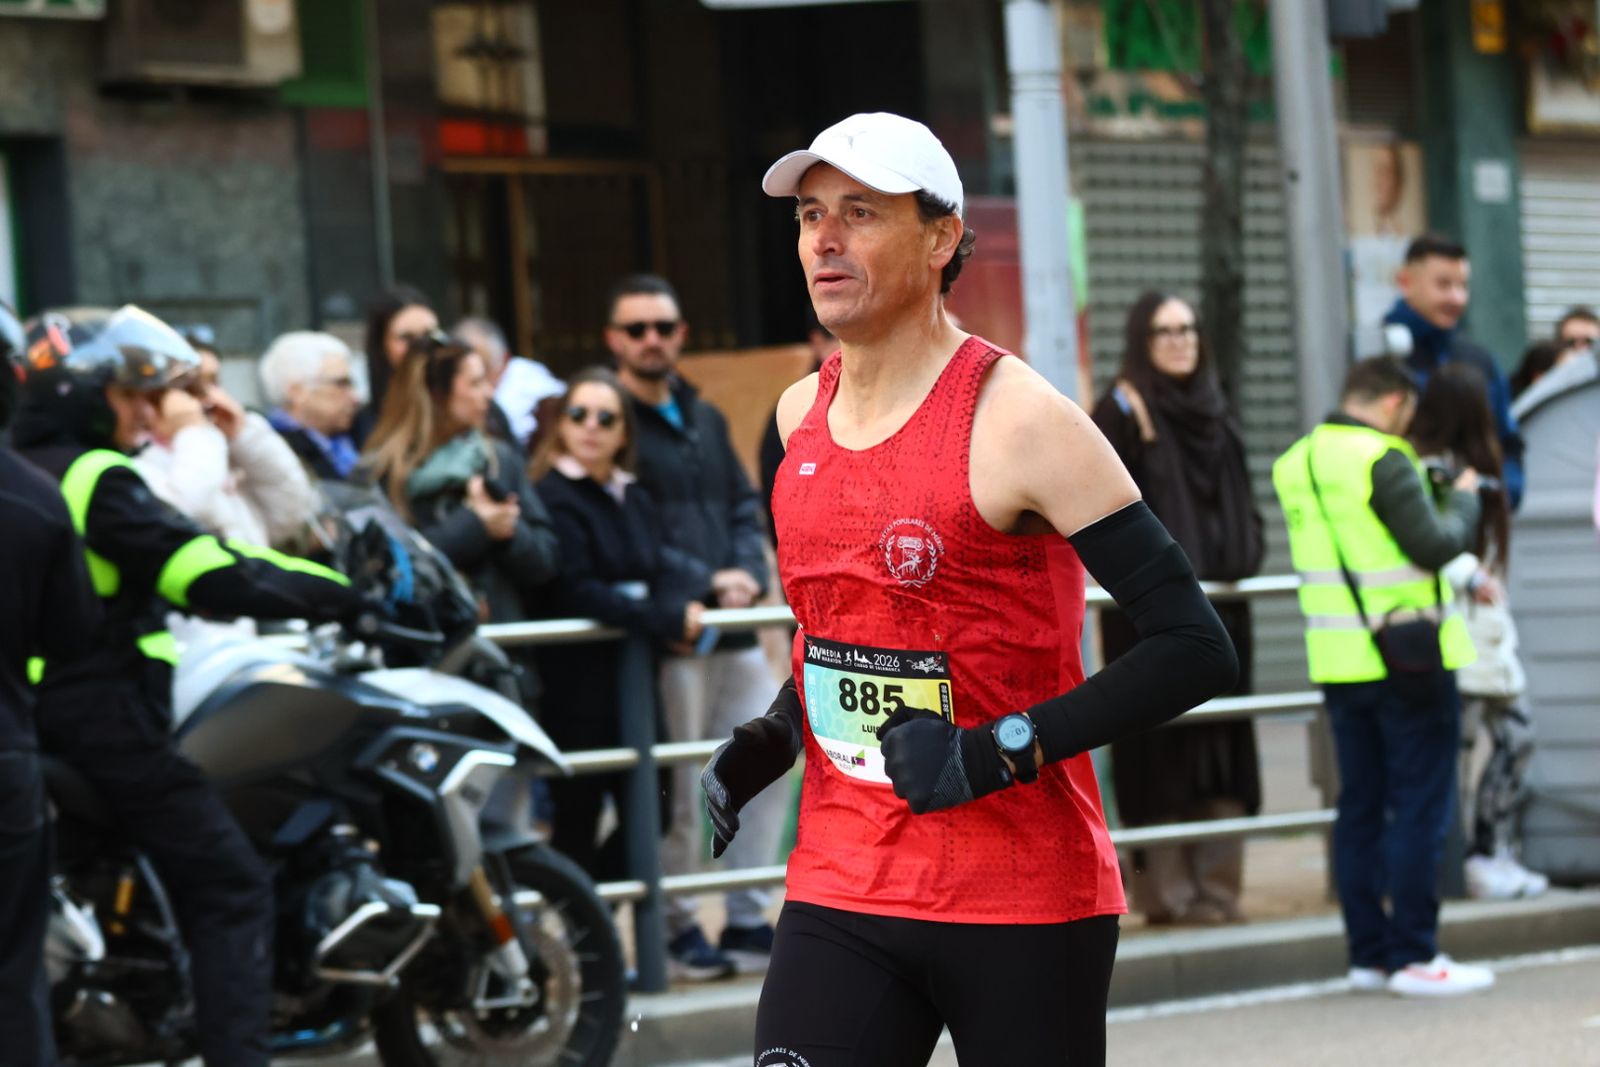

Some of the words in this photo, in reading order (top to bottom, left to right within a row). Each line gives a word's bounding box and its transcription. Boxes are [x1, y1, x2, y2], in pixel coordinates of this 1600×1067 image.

[893, 518, 924, 528] POPULARES
[925, 524, 933, 533] DE
[808, 645, 821, 660] XIV
[820, 648, 841, 659] MEDIA
[873, 653, 900, 668] 2026
[838, 678, 904, 716] 885
[788, 1050, 798, 1058] DE
